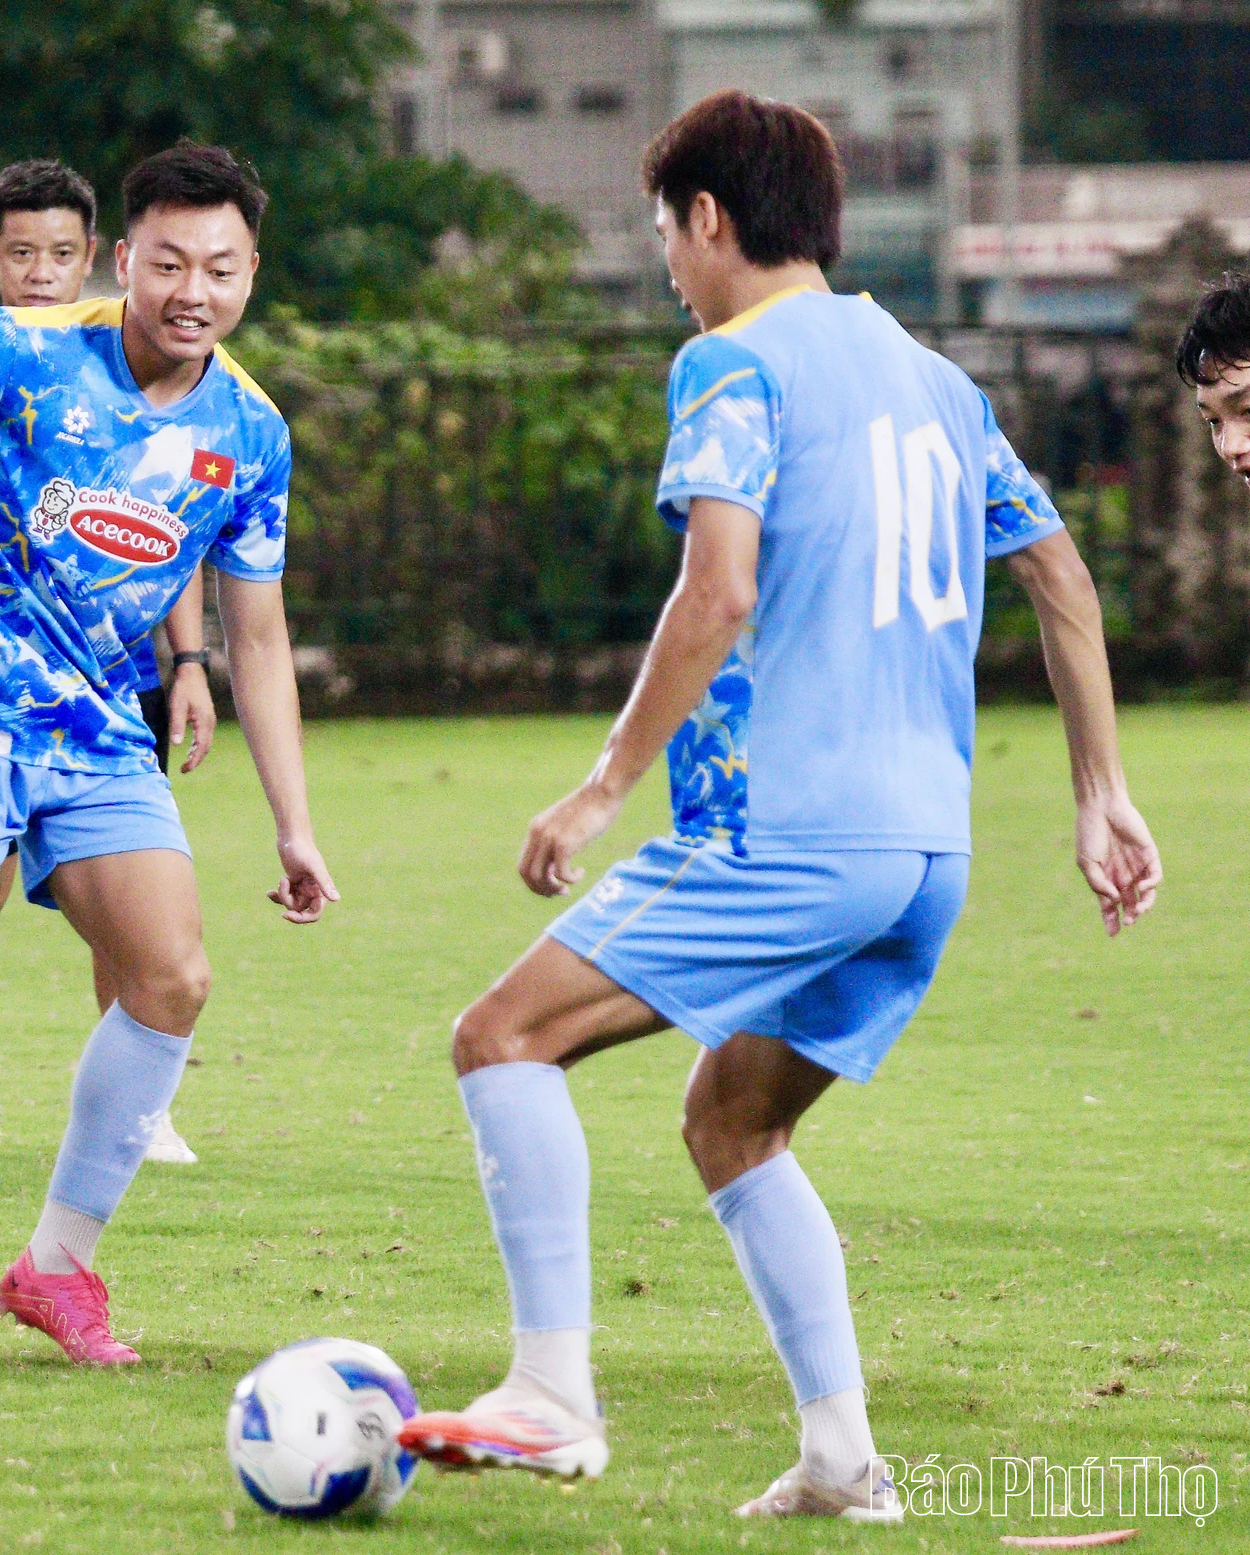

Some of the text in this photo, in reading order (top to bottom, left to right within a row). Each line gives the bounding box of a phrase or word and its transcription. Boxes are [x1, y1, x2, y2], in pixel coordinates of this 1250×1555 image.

[78, 490, 187, 539] Cook happiness
[869, 413, 968, 633] 10
